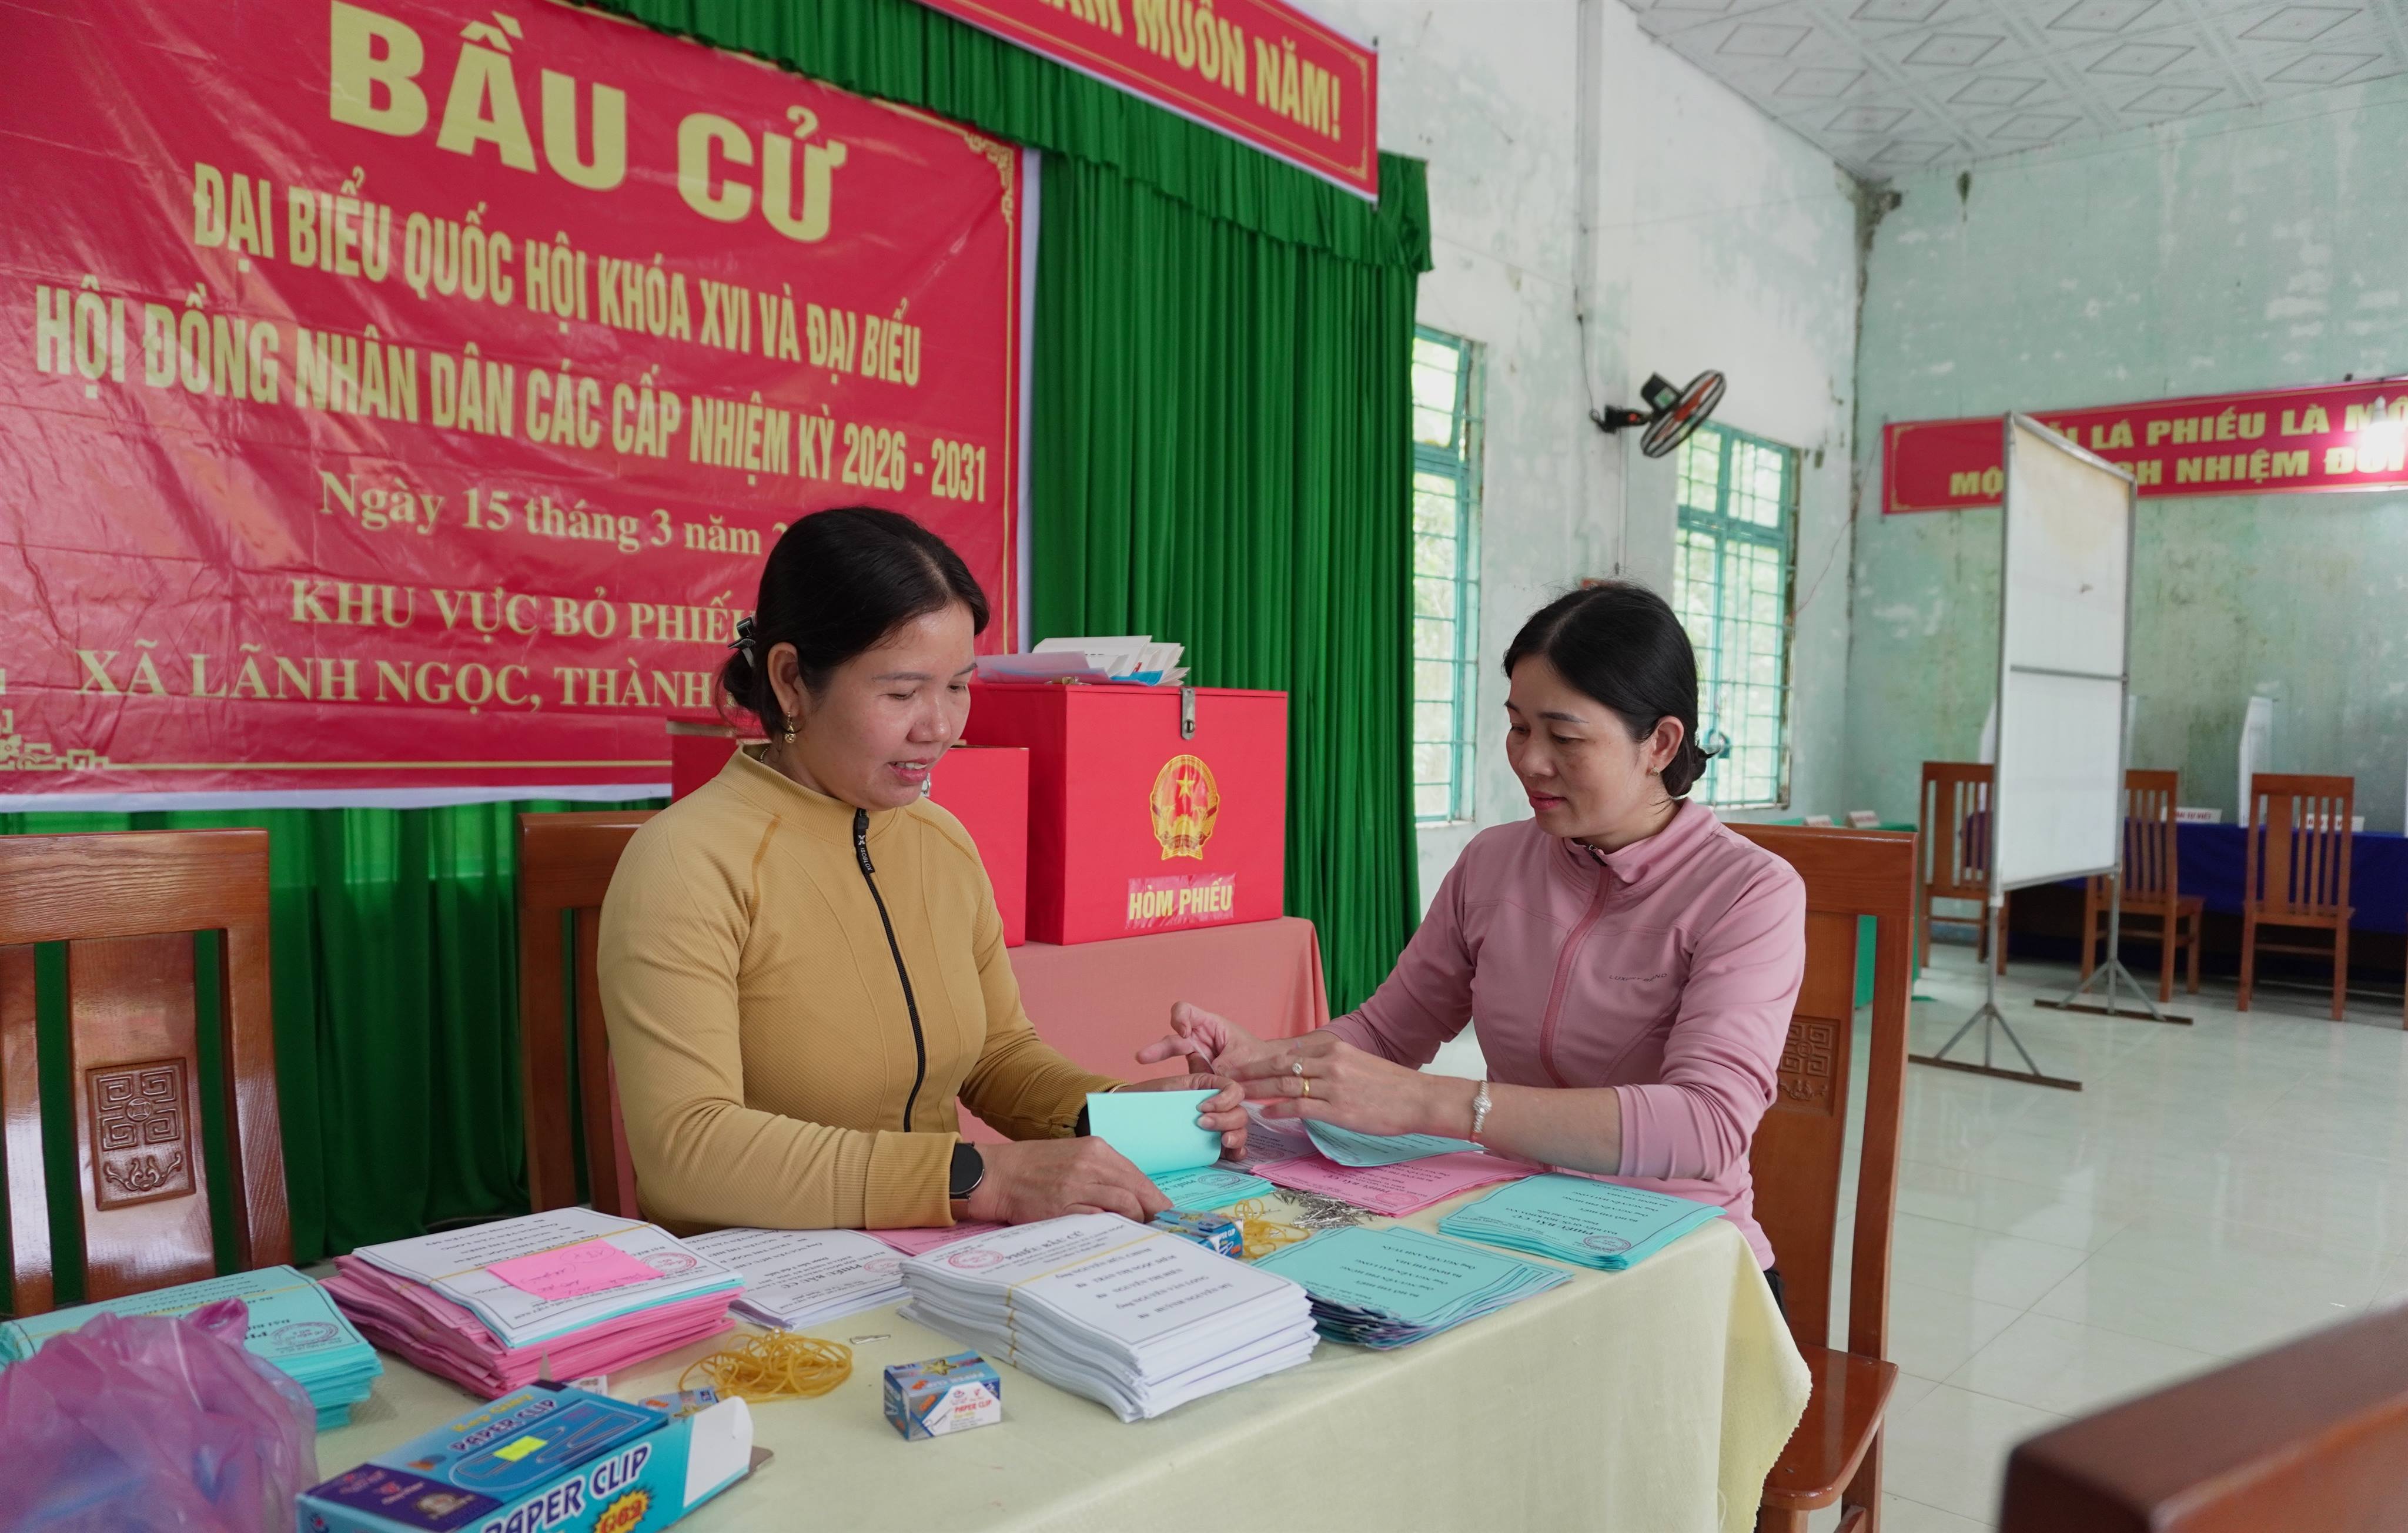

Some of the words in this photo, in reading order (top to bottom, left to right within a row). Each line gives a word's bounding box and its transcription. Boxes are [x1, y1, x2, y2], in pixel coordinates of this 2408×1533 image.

[1131, 0, 1246, 98] MUÔN
[1254, 36, 1342, 142] NĂM!
[330, 1, 626, 192] BẦU
[677, 106, 847, 243] CỬ
[193, 162, 275, 273] ĐẠI
[288, 166, 391, 283] BIỂU
[404, 201, 513, 307] QUỐC
[525, 231, 588, 334] HỘI
[597, 253, 693, 342] KHÓA
[699, 278, 751, 354] XVI
[758, 282, 801, 363] VÀ
[806, 302, 857, 385] ĐẠI
[860, 297, 921, 387] BIỂU
[36, 273, 125, 400] HỘI
[142, 283, 280, 407] ĐỒNG
[295, 323, 418, 423] NHÂN
[430, 341, 514, 439] DÂN
[526, 358, 601, 449] CÁC
[611, 364, 682, 459] CẤP
[689, 391, 790, 487] NHIỆM
[798, 404, 835, 480] KỲ
[843, 422, 908, 492] 2026
[914, 462, 924, 474] -
[931, 439, 988, 503] 2031
[2146, 406, 2267, 447] PHIẾU
[2280, 403, 2331, 437] LÀ
[1949, 465, 2004, 500] MỘ
[2175, 448, 2310, 484] NHIỆM
[320, 470, 446, 535] Ngày
[461, 487, 510, 531] 15
[524, 495, 640, 554] tháng
[650, 509, 673, 547] 3
[683, 513, 762, 555] năm
[289, 578, 417, 628] KHU
[431, 586, 539, 643] VỰC
[553, 585, 616, 639] BỎ
[74, 638, 172, 696] XÃ
[188, 642, 360, 701] LÃNH
[375, 660, 542, 715] NGỌC,
[554, 658, 713, 708] THÀNH
[1128, 885, 1173, 921] HÒM
[1178, 877, 1233, 915] PHIẾU
[449, 1417, 524, 1452] PAPER
[592, 1445, 649, 1496] CLIP
